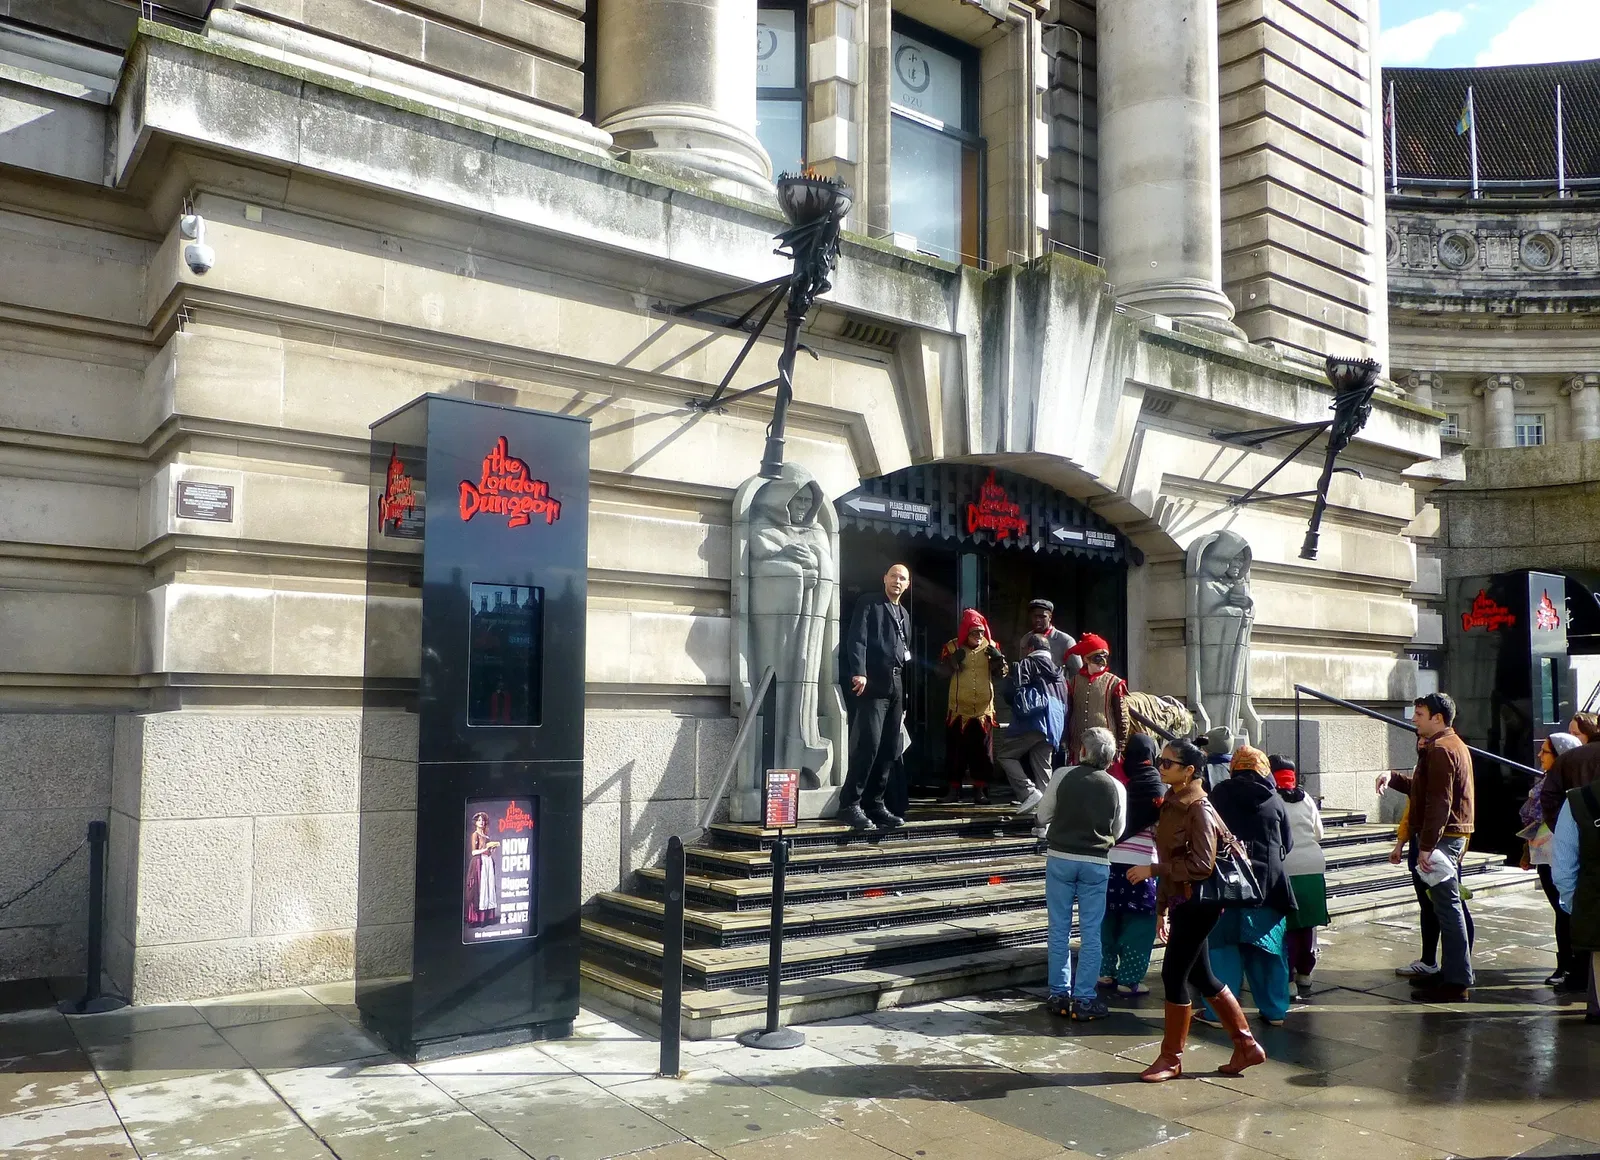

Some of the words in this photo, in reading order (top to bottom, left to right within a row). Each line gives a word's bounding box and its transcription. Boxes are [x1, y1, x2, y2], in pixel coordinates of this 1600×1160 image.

[902, 93, 922, 109] OZU
[488, 436, 521, 476] the
[479, 458, 547, 499] London
[459, 480, 561, 529] Dungeon
[889, 501, 904, 510] PLEASE
[912, 504, 929, 514] GENERAL
[891, 509, 898, 518] OR
[897, 510, 915, 520] PRIORITY
[915, 512, 927, 522] QUEUE
[967, 502, 1029, 539] Dungeon
[501, 838, 529, 856] NOW
[501, 855, 531, 873] OPEN
[500, 913, 507, 925] &
